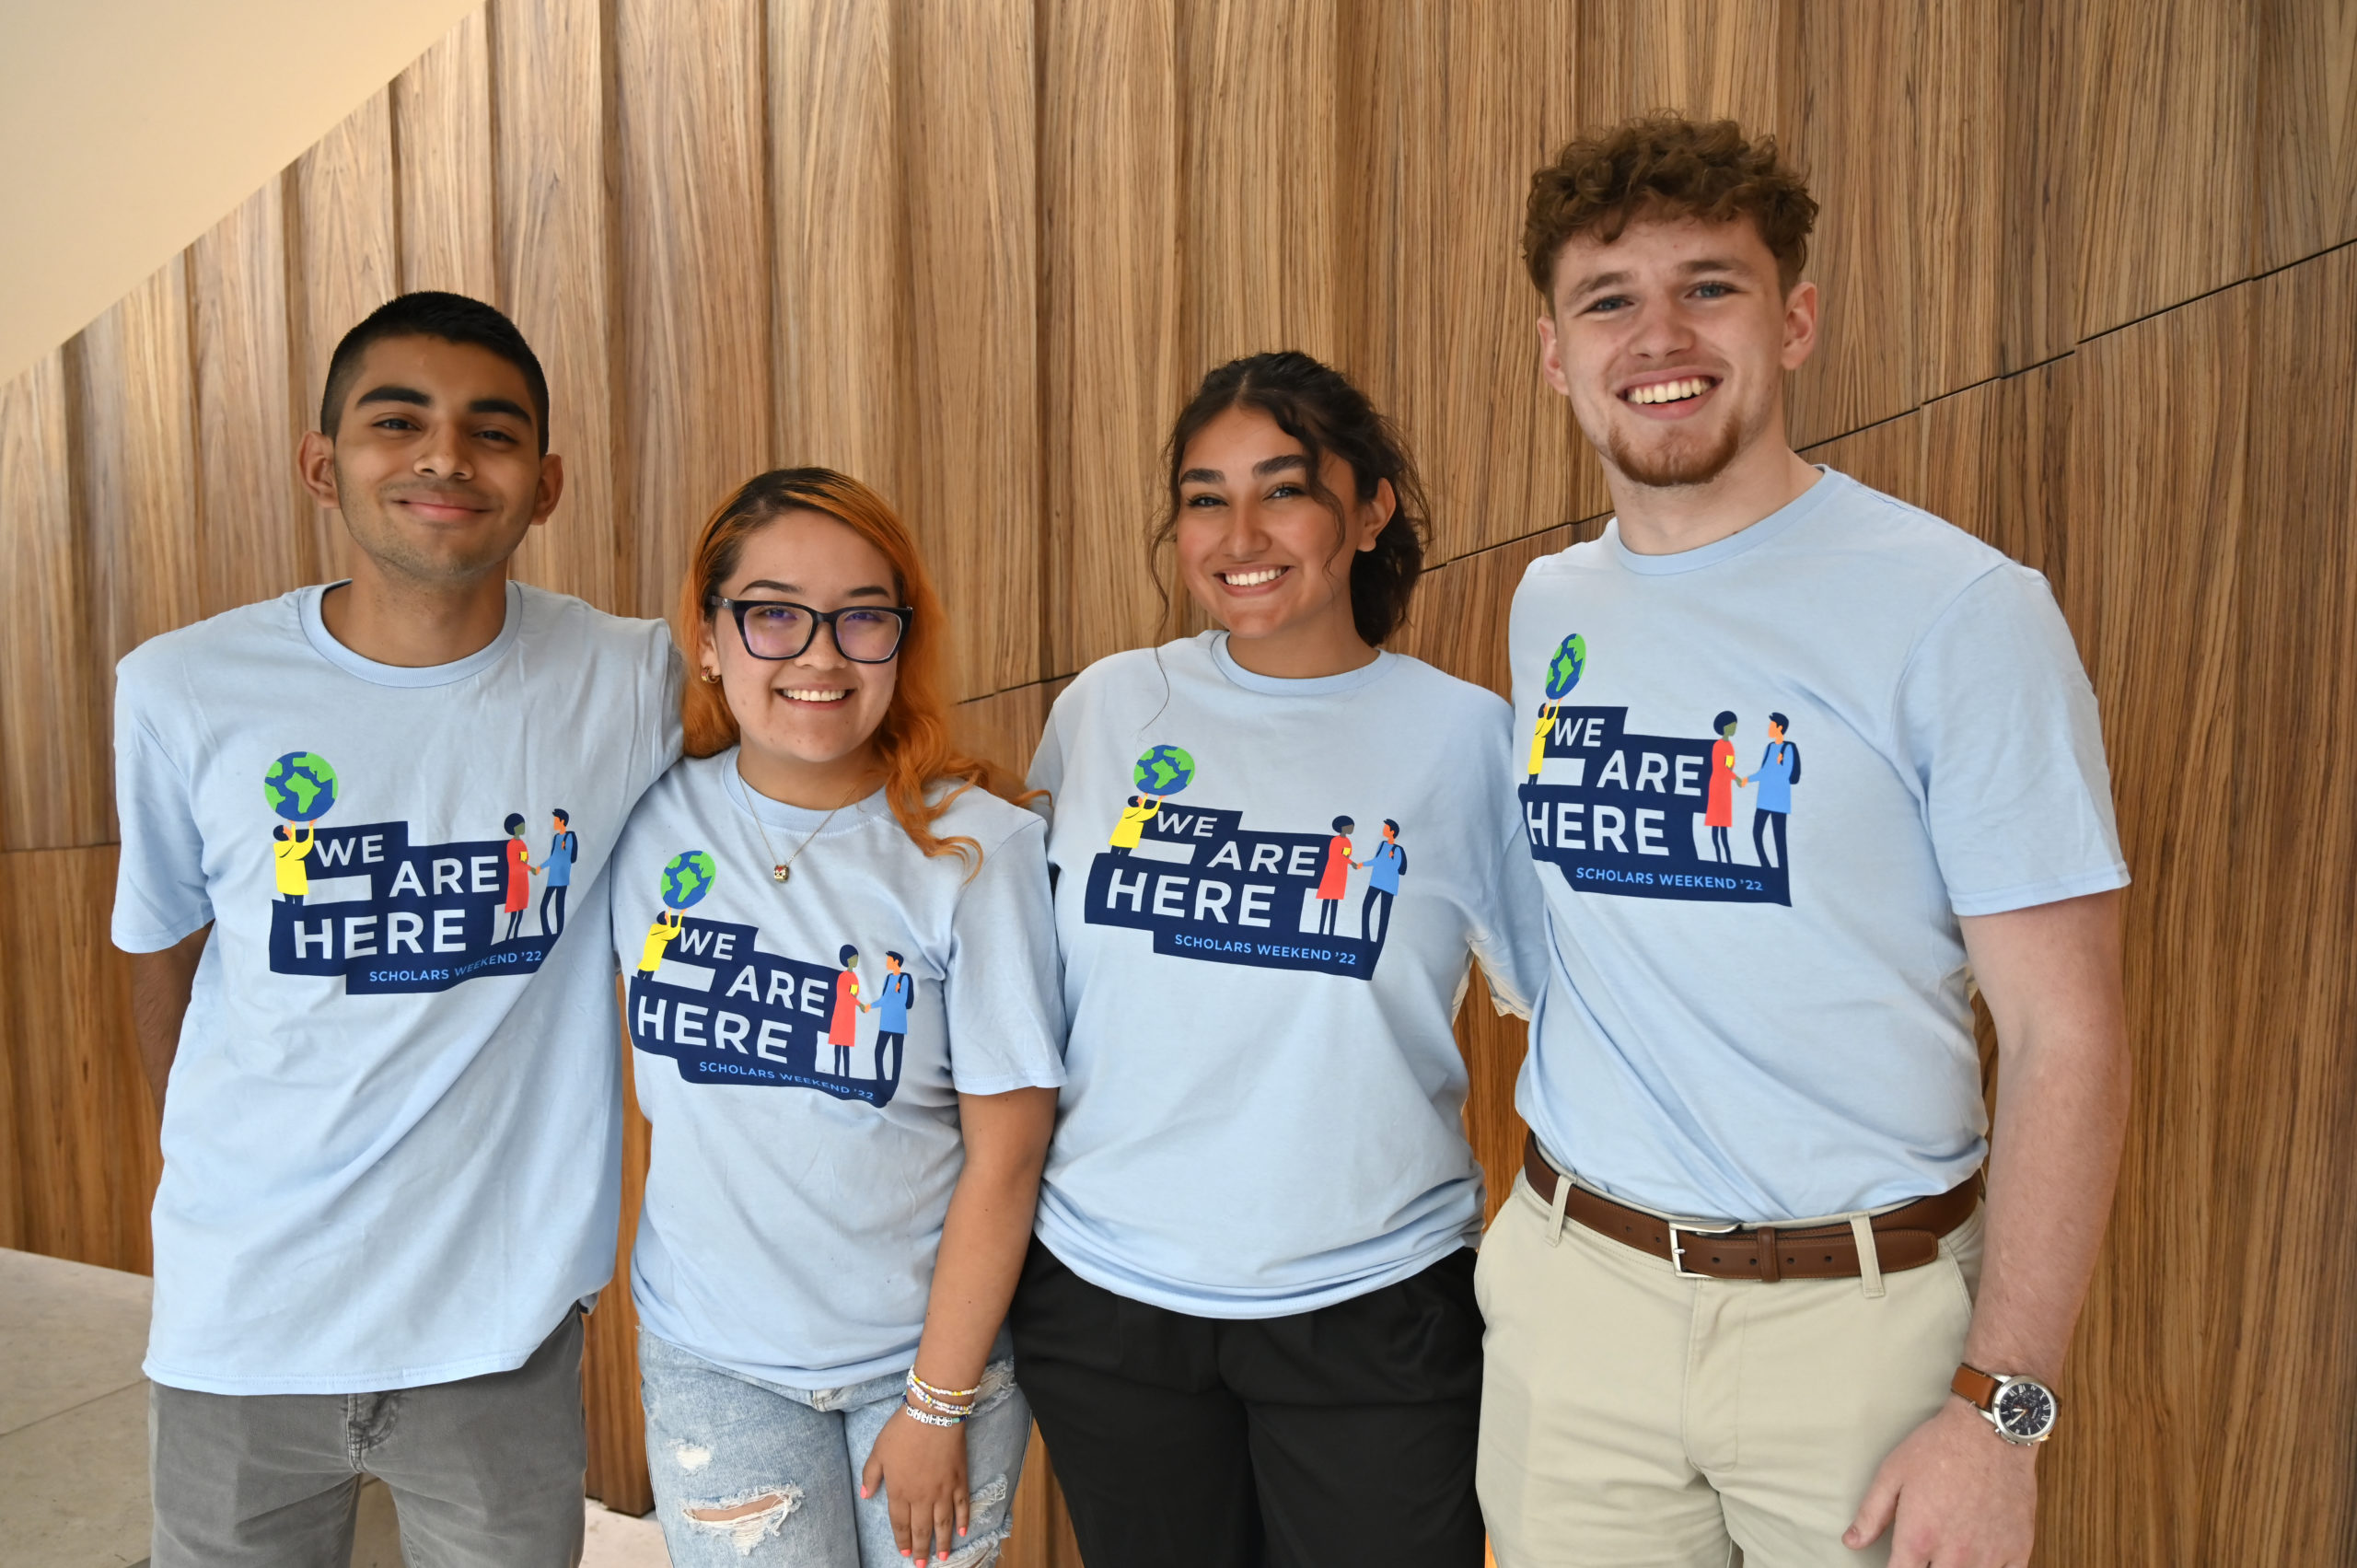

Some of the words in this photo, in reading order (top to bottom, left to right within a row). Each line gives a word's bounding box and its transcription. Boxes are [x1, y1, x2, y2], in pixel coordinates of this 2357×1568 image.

[1553, 717, 1606, 748] WE
[1596, 749, 1704, 797] ARE
[1157, 810, 1218, 838] WE
[1527, 801, 1670, 856] HERE
[314, 834, 385, 867] WE
[1206, 841, 1320, 877] ARE
[389, 855, 500, 898] ARE
[1575, 866, 1654, 885] SCHOLARS
[1659, 874, 1737, 889] WEEKEND
[1106, 868, 1276, 928] HERE
[294, 909, 467, 959] HERE
[679, 926, 737, 961] WE
[1175, 934, 1252, 954] SCHOLARS
[1257, 944, 1331, 961] WEEKEND
[369, 970, 449, 982] SCHOLARS
[454, 952, 518, 977] WEEKEND
[726, 965, 829, 1018] ARE
[637, 995, 793, 1064] HERE
[699, 1061, 775, 1079] SCHOLARS
[780, 1073, 851, 1095] WEEKEND
